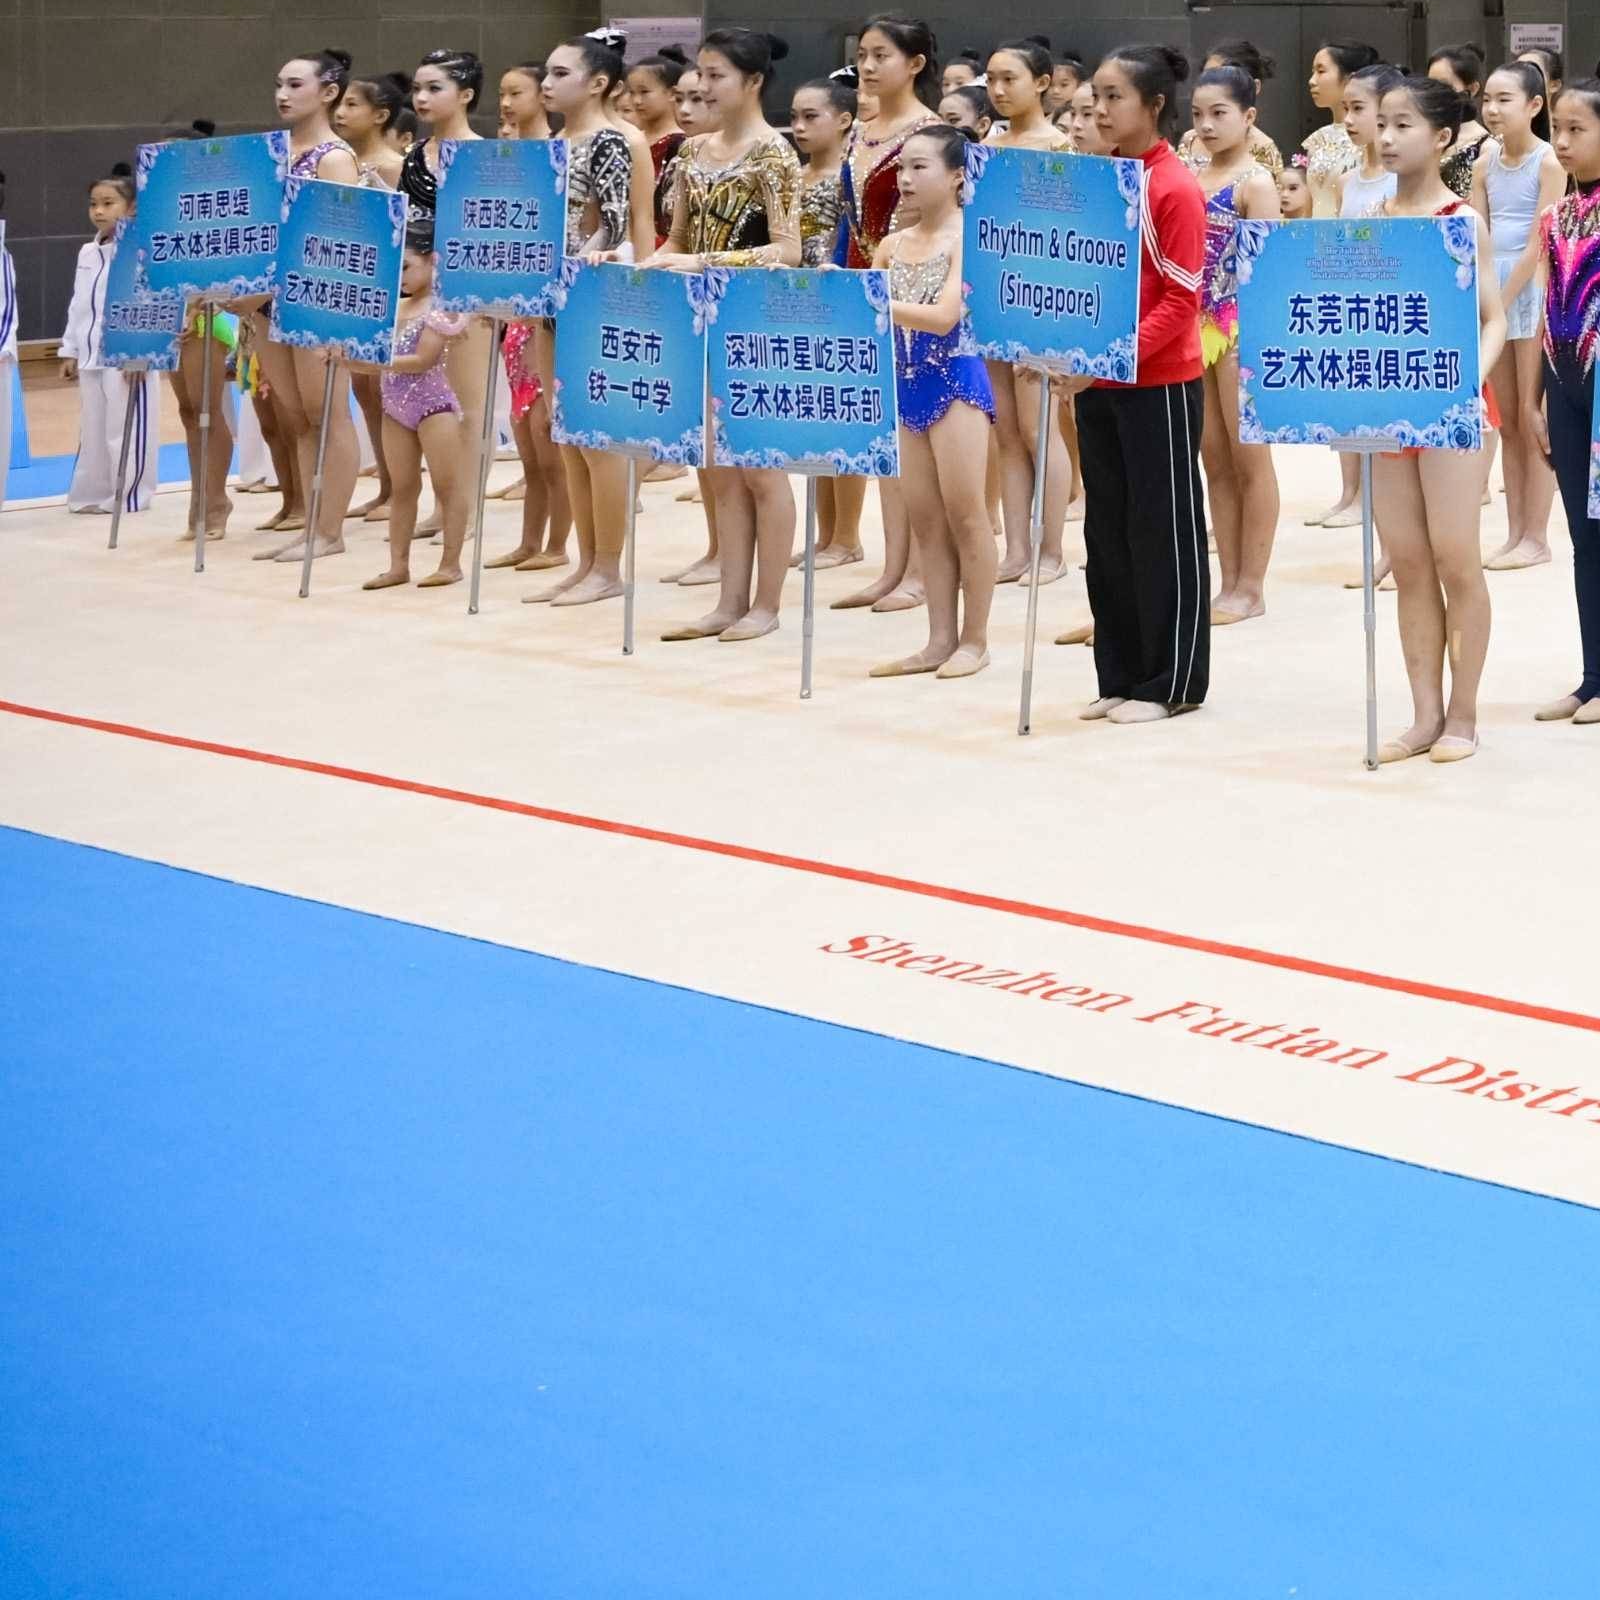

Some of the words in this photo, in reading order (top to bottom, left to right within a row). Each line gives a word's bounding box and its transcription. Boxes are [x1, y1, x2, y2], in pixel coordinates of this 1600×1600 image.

[151, 223, 279, 263] 艺术体操俱乐部
[445, 239, 554, 275] 艺术体操俱乐部
[976, 217, 1044, 265] Rhythm
[1047, 230, 1061, 259] &
[1065, 230, 1129, 270] Groove
[284, 271, 389, 322] 艺术体操俱乐部
[998, 267, 1102, 328] (Singapore)
[1287, 291, 1431, 338] 东莞市胡美
[599, 323, 664, 367] 西安市
[725, 332, 880, 376] 深圳市星屹灵动
[586, 367, 673, 417] 铁一中学
[1260, 347, 1462, 394] 艺术体操俱乐部
[728, 380, 883, 425] 艺术体操俱乐部
[820, 934, 1134, 1013] Shenzhen
[1135, 999, 1389, 1070] Futian
